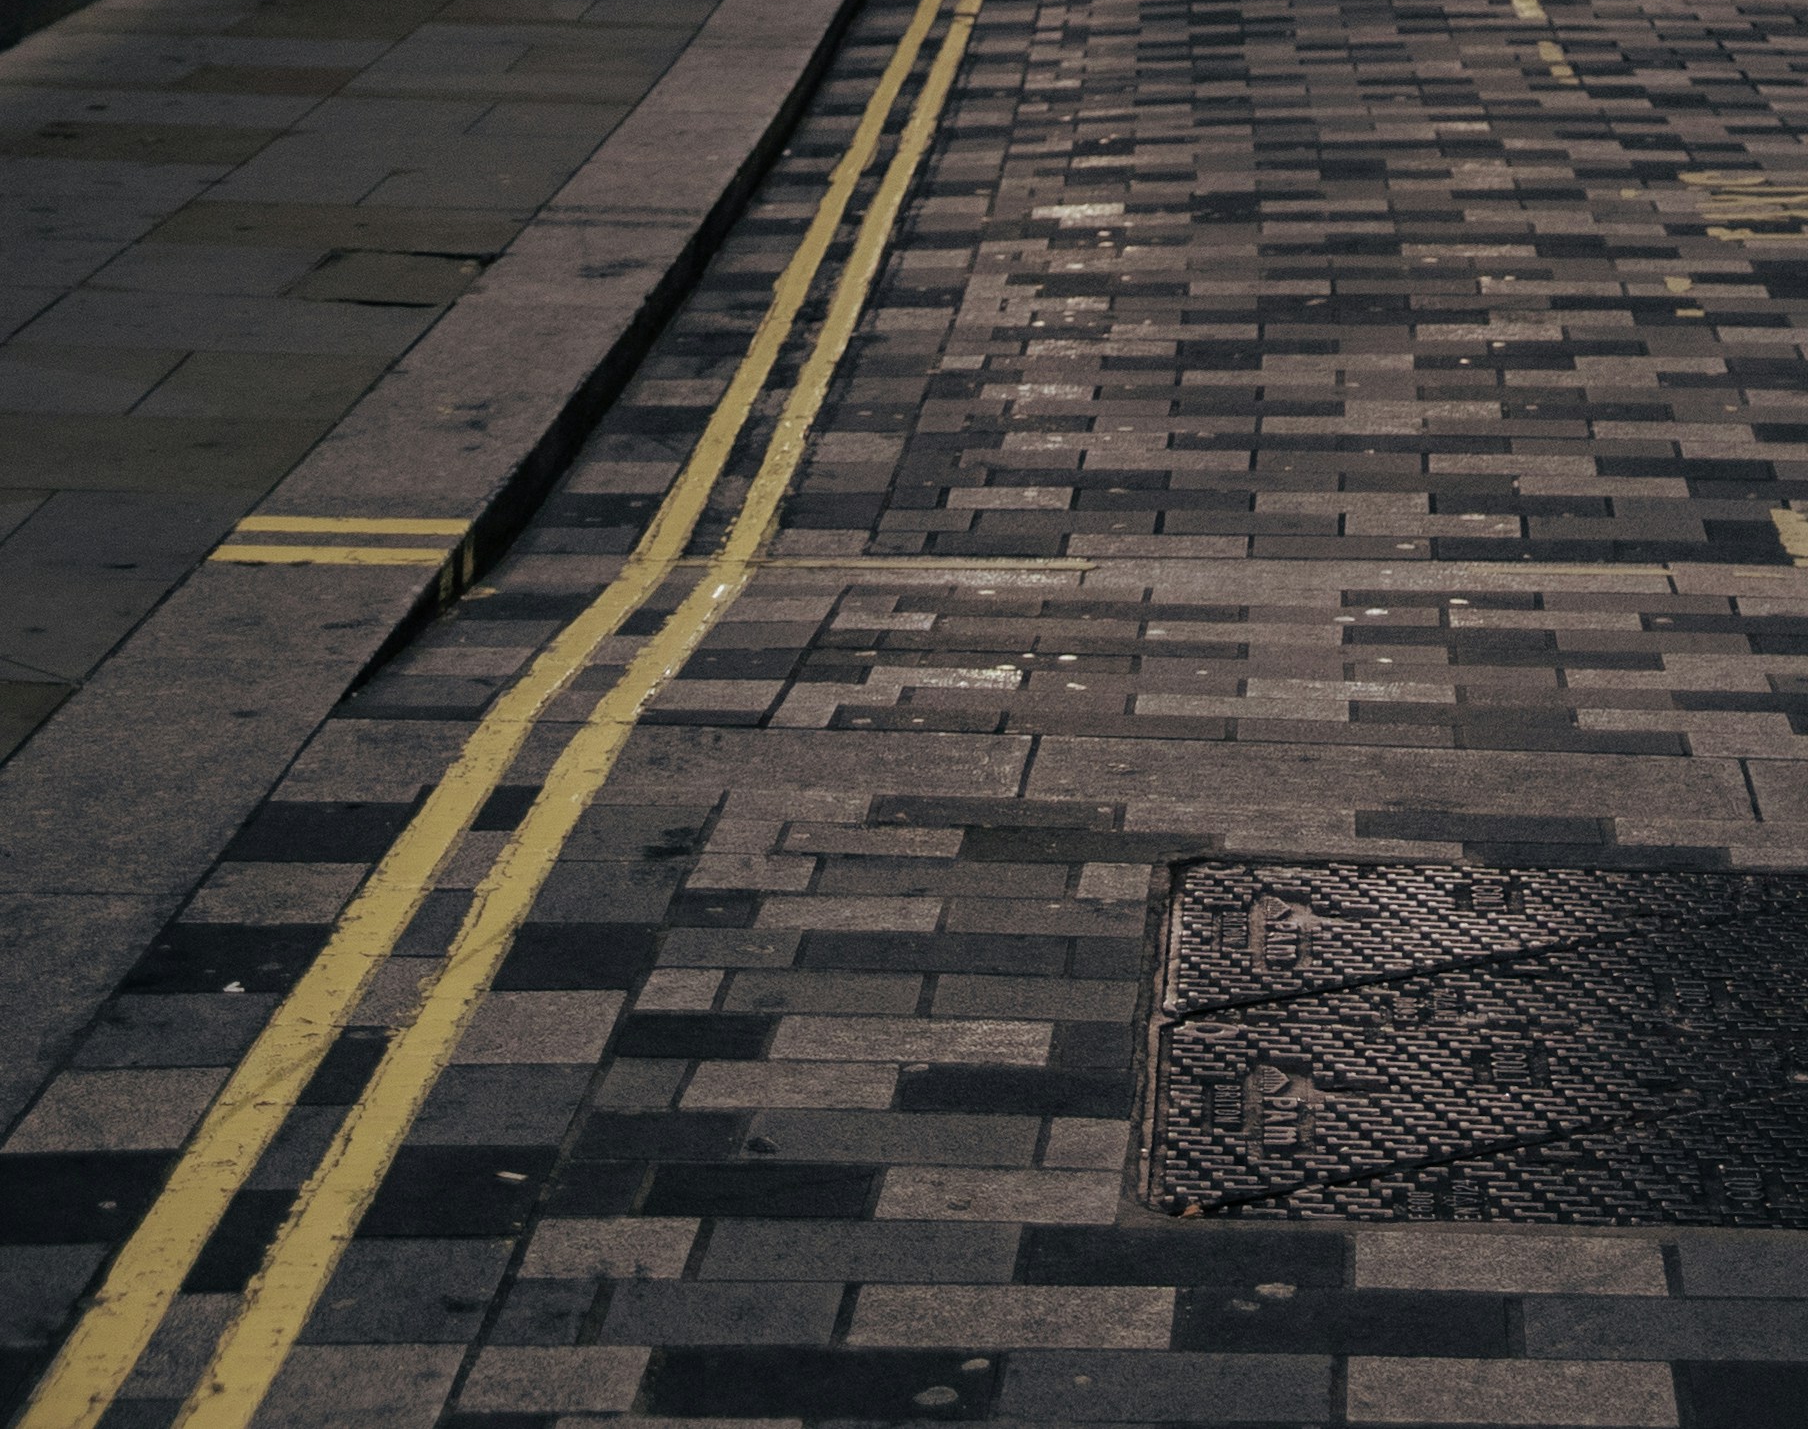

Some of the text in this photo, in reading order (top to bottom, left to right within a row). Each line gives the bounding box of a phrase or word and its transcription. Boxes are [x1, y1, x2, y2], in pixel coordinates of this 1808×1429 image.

[1489, 1051, 1532, 1086] COLT
[1213, 1083, 1241, 1123] BRITON
[1406, 1191, 1436, 1220] E600
